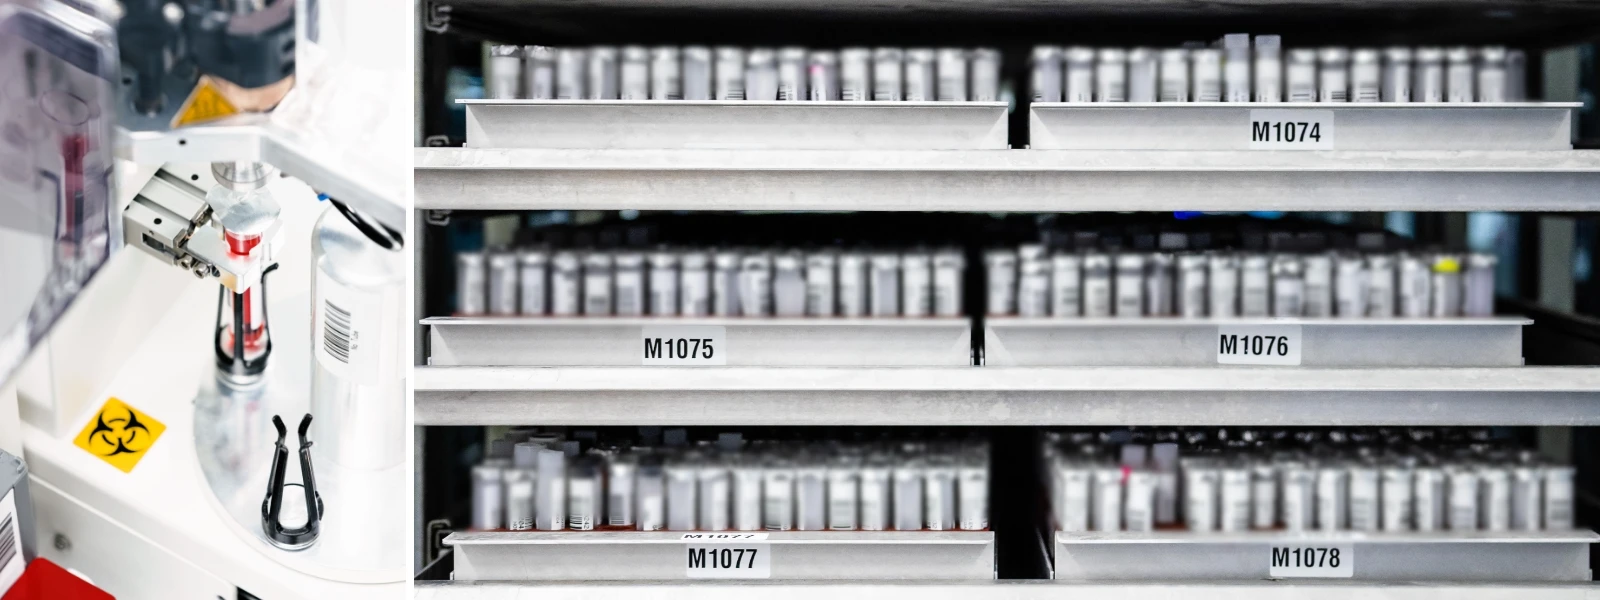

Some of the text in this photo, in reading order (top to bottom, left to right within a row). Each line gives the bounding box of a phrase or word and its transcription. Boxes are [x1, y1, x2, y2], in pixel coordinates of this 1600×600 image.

[1252, 121, 1321, 142] M1074
[644, 338, 713, 359] M1075
[1220, 334, 1288, 356] M1076
[688, 547, 757, 569] M1077
[1272, 547, 1340, 568] M1078
